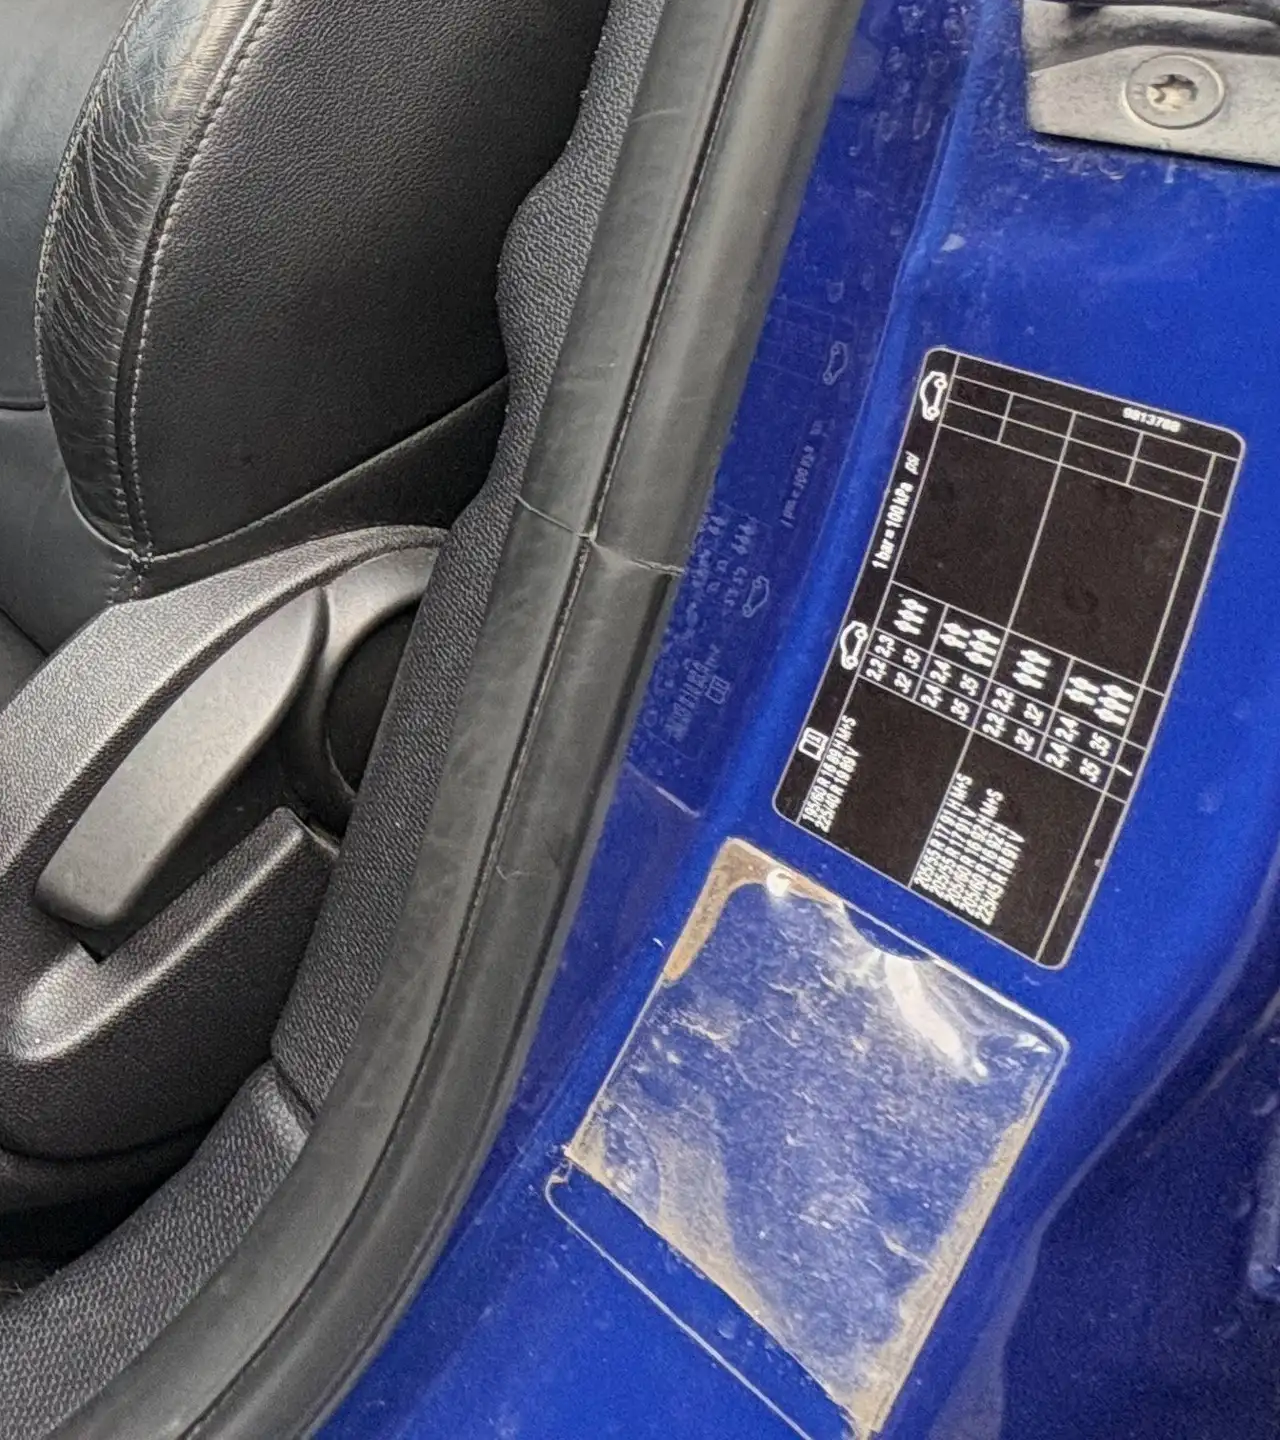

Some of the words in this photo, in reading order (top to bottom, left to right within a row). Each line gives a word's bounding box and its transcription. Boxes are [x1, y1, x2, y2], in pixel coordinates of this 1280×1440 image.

[905, 452, 919, 474] psi
[893, 483, 913, 505] kPa
[886, 505, 905, 527] 100
[876, 539, 894, 561] bar
[875, 635, 895, 657] 2,3
[866, 659, 886, 680] 2,2
[894, 672, 911, 693] 32
[903, 649, 920, 669] 33
[930, 660, 951, 683] 2,4
[921, 684, 942, 707] 2,4
[951, 699, 969, 720] 35
[960, 674, 978, 696] 35
[992, 688, 1014, 712] 2,2
[983, 713, 1005, 737] 2,2
[1024, 703, 1043, 726] 32
[1015, 729, 1034, 751] 32
[1055, 717, 1079, 742] 2,4
[1045, 743, 1069, 767] 2,4
[1080, 759, 1100, 782] 35
[1090, 733, 1110, 756] 35
[803, 786, 826, 823] 195/60
[836, 716, 855, 741] M+S
[816, 794, 840, 831] 225/40
[981, 789, 1003, 817] M+S
[915, 849, 940, 889] 205/55
[934, 823, 951, 840] 17
[950, 774, 972, 801] M+S
[930, 857, 955, 898] 205/55
[949, 831, 967, 848] 17
